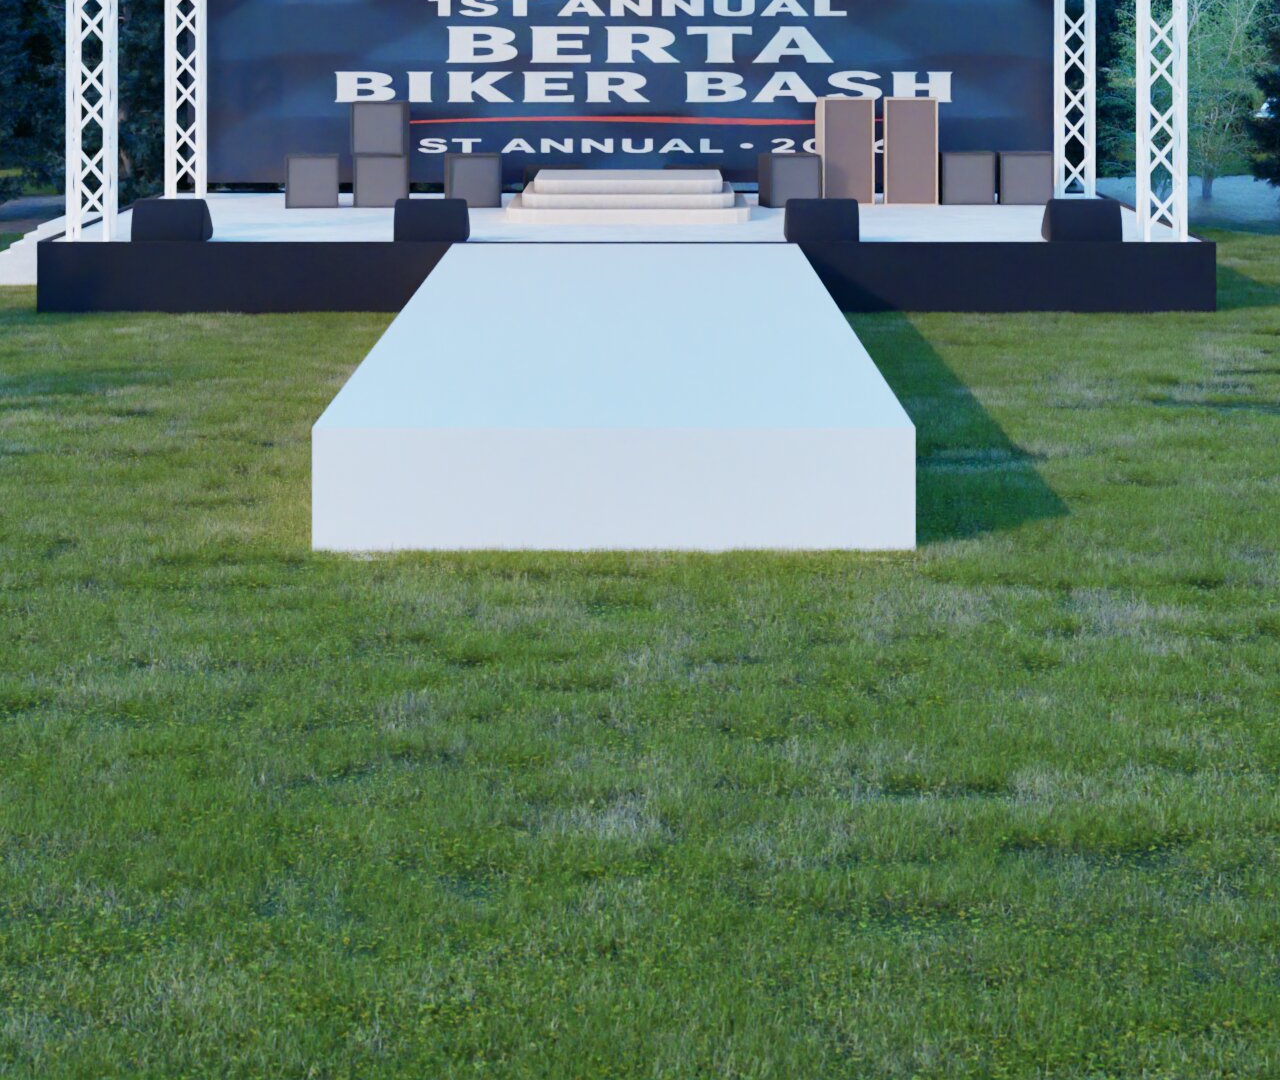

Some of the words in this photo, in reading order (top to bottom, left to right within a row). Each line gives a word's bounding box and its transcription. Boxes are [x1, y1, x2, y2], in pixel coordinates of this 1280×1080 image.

[445, 25, 834, 64] BERTA
[334, 71, 649, 103] BIKER
[684, 70, 953, 103] BASH
[417, 137, 482, 154] ST
[501, 137, 724, 154] ANNUAL
